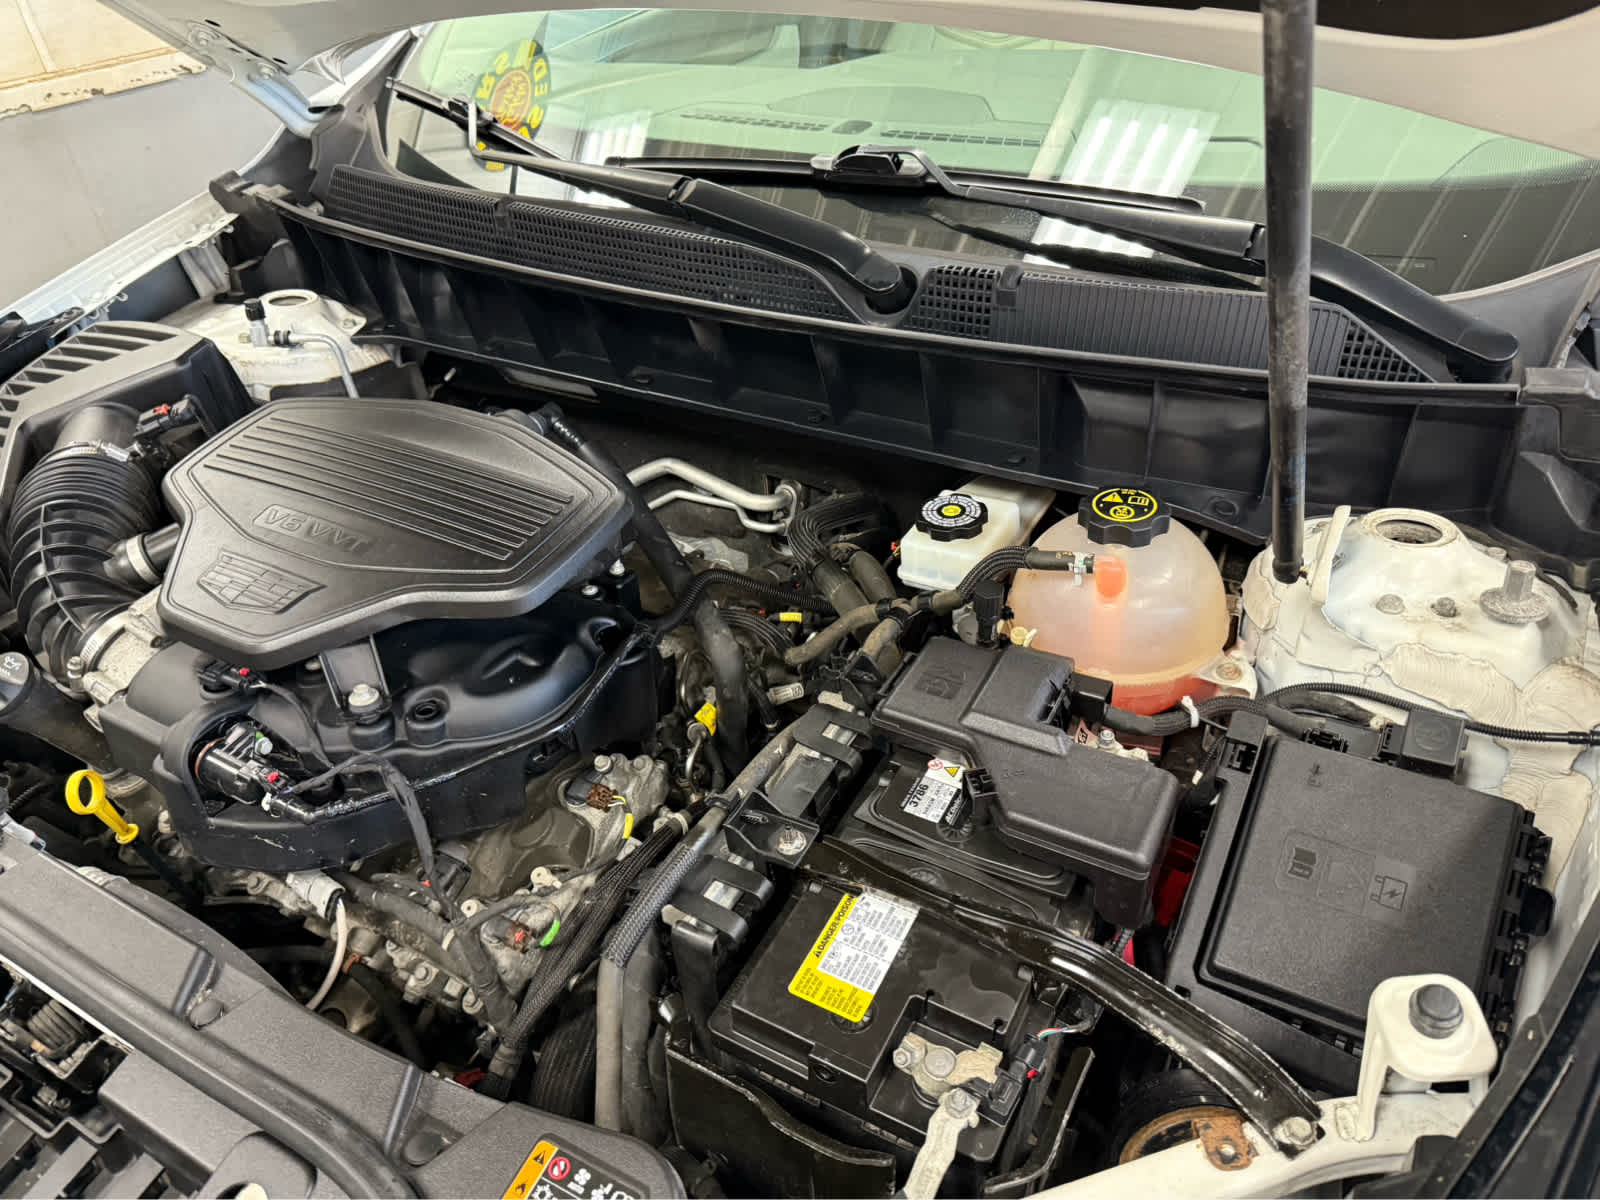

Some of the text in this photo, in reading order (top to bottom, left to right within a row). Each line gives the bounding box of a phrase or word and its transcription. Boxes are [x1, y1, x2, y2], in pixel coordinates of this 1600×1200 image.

[265, 508, 368, 551] V6 VVT
[909, 783, 929, 808] 3786
